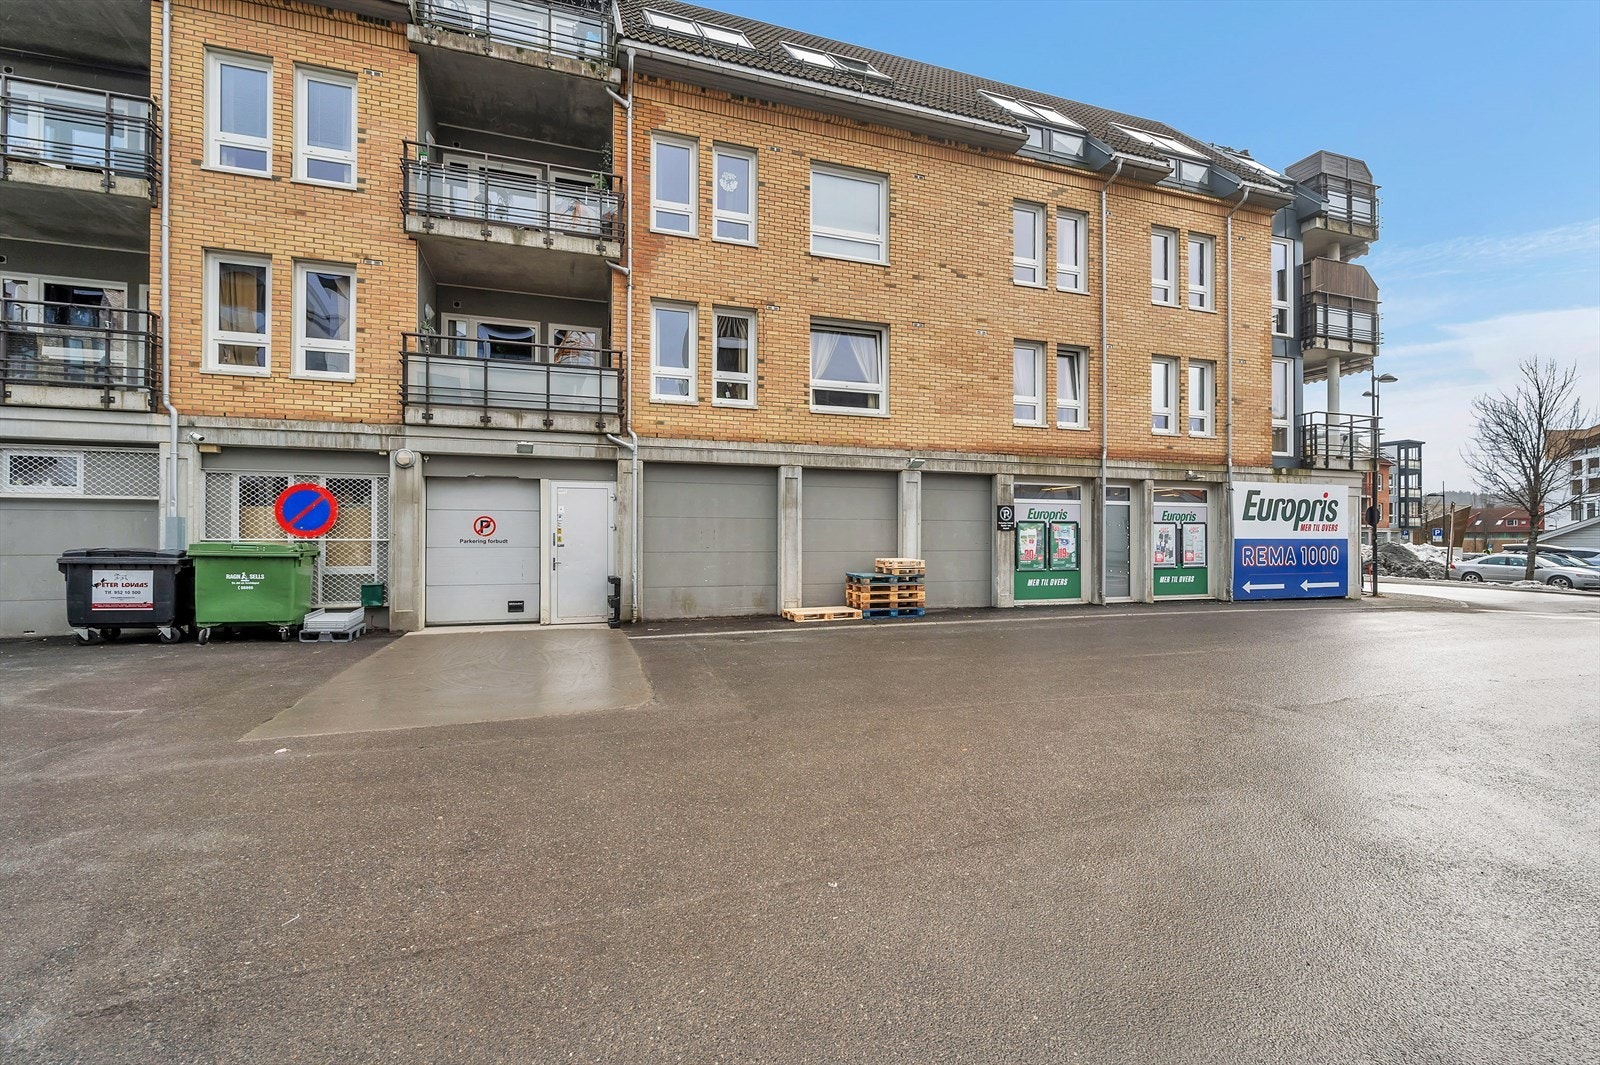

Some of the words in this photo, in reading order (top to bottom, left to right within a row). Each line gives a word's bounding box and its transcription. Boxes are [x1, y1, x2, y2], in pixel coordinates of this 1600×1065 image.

[1027, 508, 1068, 522] Europris
[1161, 510, 1197, 522] Europris
[1242, 489, 1339, 531] Europris
[480, 520, 490, 533] P
[1300, 523, 1311, 532] MER
[1312, 523, 1320, 532] TIL
[1321, 523, 1339, 532] OVERS
[1242, 545, 1297, 567] REMA
[1300, 545, 1339, 566] 1000
[1027, 578, 1040, 586] MER
[1040, 578, 1049, 586] TIL
[1049, 578, 1069, 586] OVERS
[1178, 575, 1195, 583] OVERS
